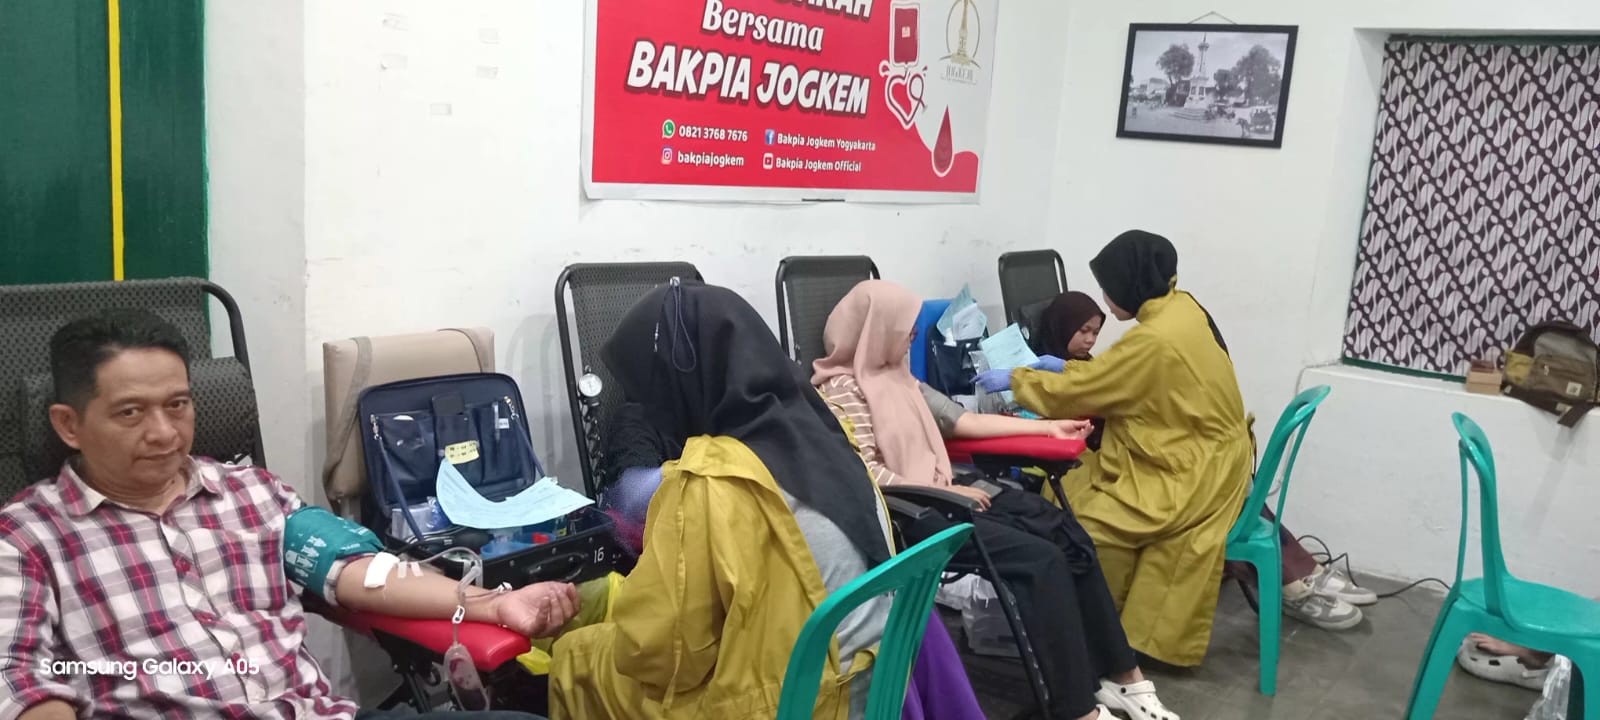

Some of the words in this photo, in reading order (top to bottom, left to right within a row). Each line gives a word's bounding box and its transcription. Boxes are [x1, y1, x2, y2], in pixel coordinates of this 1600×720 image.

[702, 0, 824, 51] Bersama
[627, 40, 751, 100] BAKPIA
[756, 61, 870, 114] JOGKEM
[679, 125, 702, 138] 0821
[703, 127, 726, 140] 3768
[727, 129, 748, 142] 7676
[777, 132, 805, 147] Bakpia
[806, 136, 835, 149] Jogkem
[836, 138, 876, 151] Yogyakarta
[677, 150, 744, 168] bakpiajogkem
[776, 157, 803, 171] Bakpia
[804, 159, 833, 172] Jogkem
[834, 160, 862, 172] Official
[593, 546, 604, 564] 16
